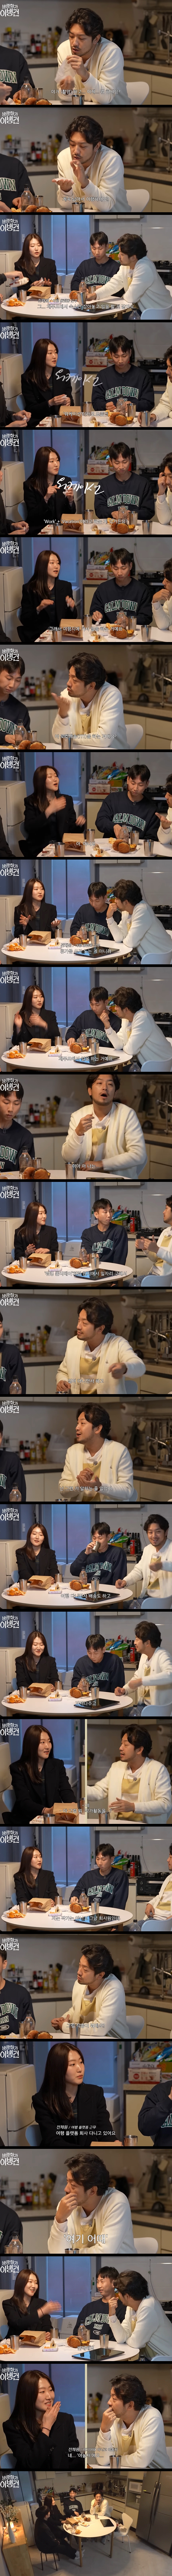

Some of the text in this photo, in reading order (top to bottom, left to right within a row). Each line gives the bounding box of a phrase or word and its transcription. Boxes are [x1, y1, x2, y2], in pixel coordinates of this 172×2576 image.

[85, 275, 111, 284] CALM DOW
[105, 386, 139, 400] CALM DOWN
[123, 494, 140, 507] DOWN
[104, 600, 120, 613] CALM
[128, 814, 146, 831] DOWN
[85, 1563, 100, 1573] CALM
[87, 1885, 102, 1896] CALM
[1, 2003, 18, 2019] DOWN
[85, 2313, 102, 2325] CALM
